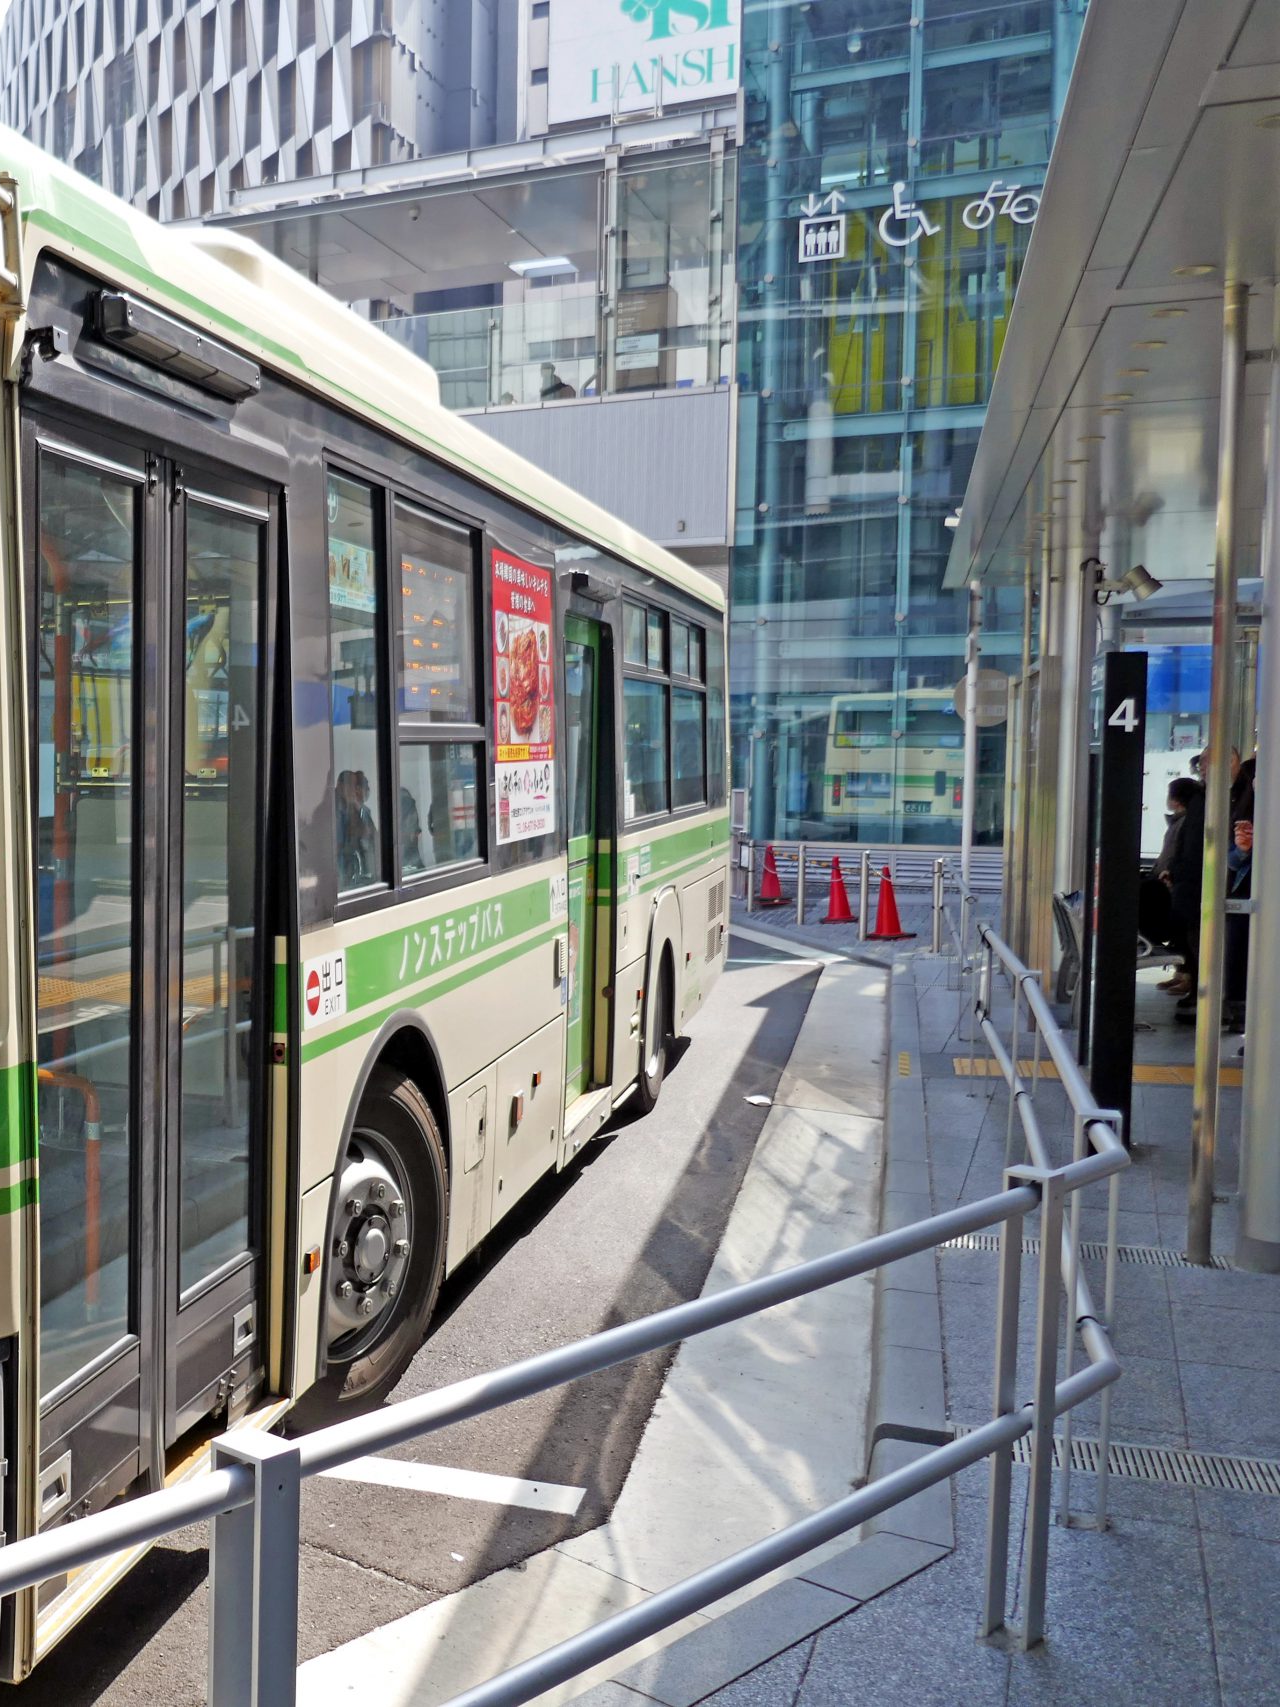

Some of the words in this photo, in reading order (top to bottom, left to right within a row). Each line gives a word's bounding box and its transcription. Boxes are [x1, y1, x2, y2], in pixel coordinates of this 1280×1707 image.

[1108, 698, 1139, 732] 4
[398, 902, 504, 981] ノンステップバス
[322, 958, 343, 992] 出口
[324, 994, 341, 1016] EXIT
